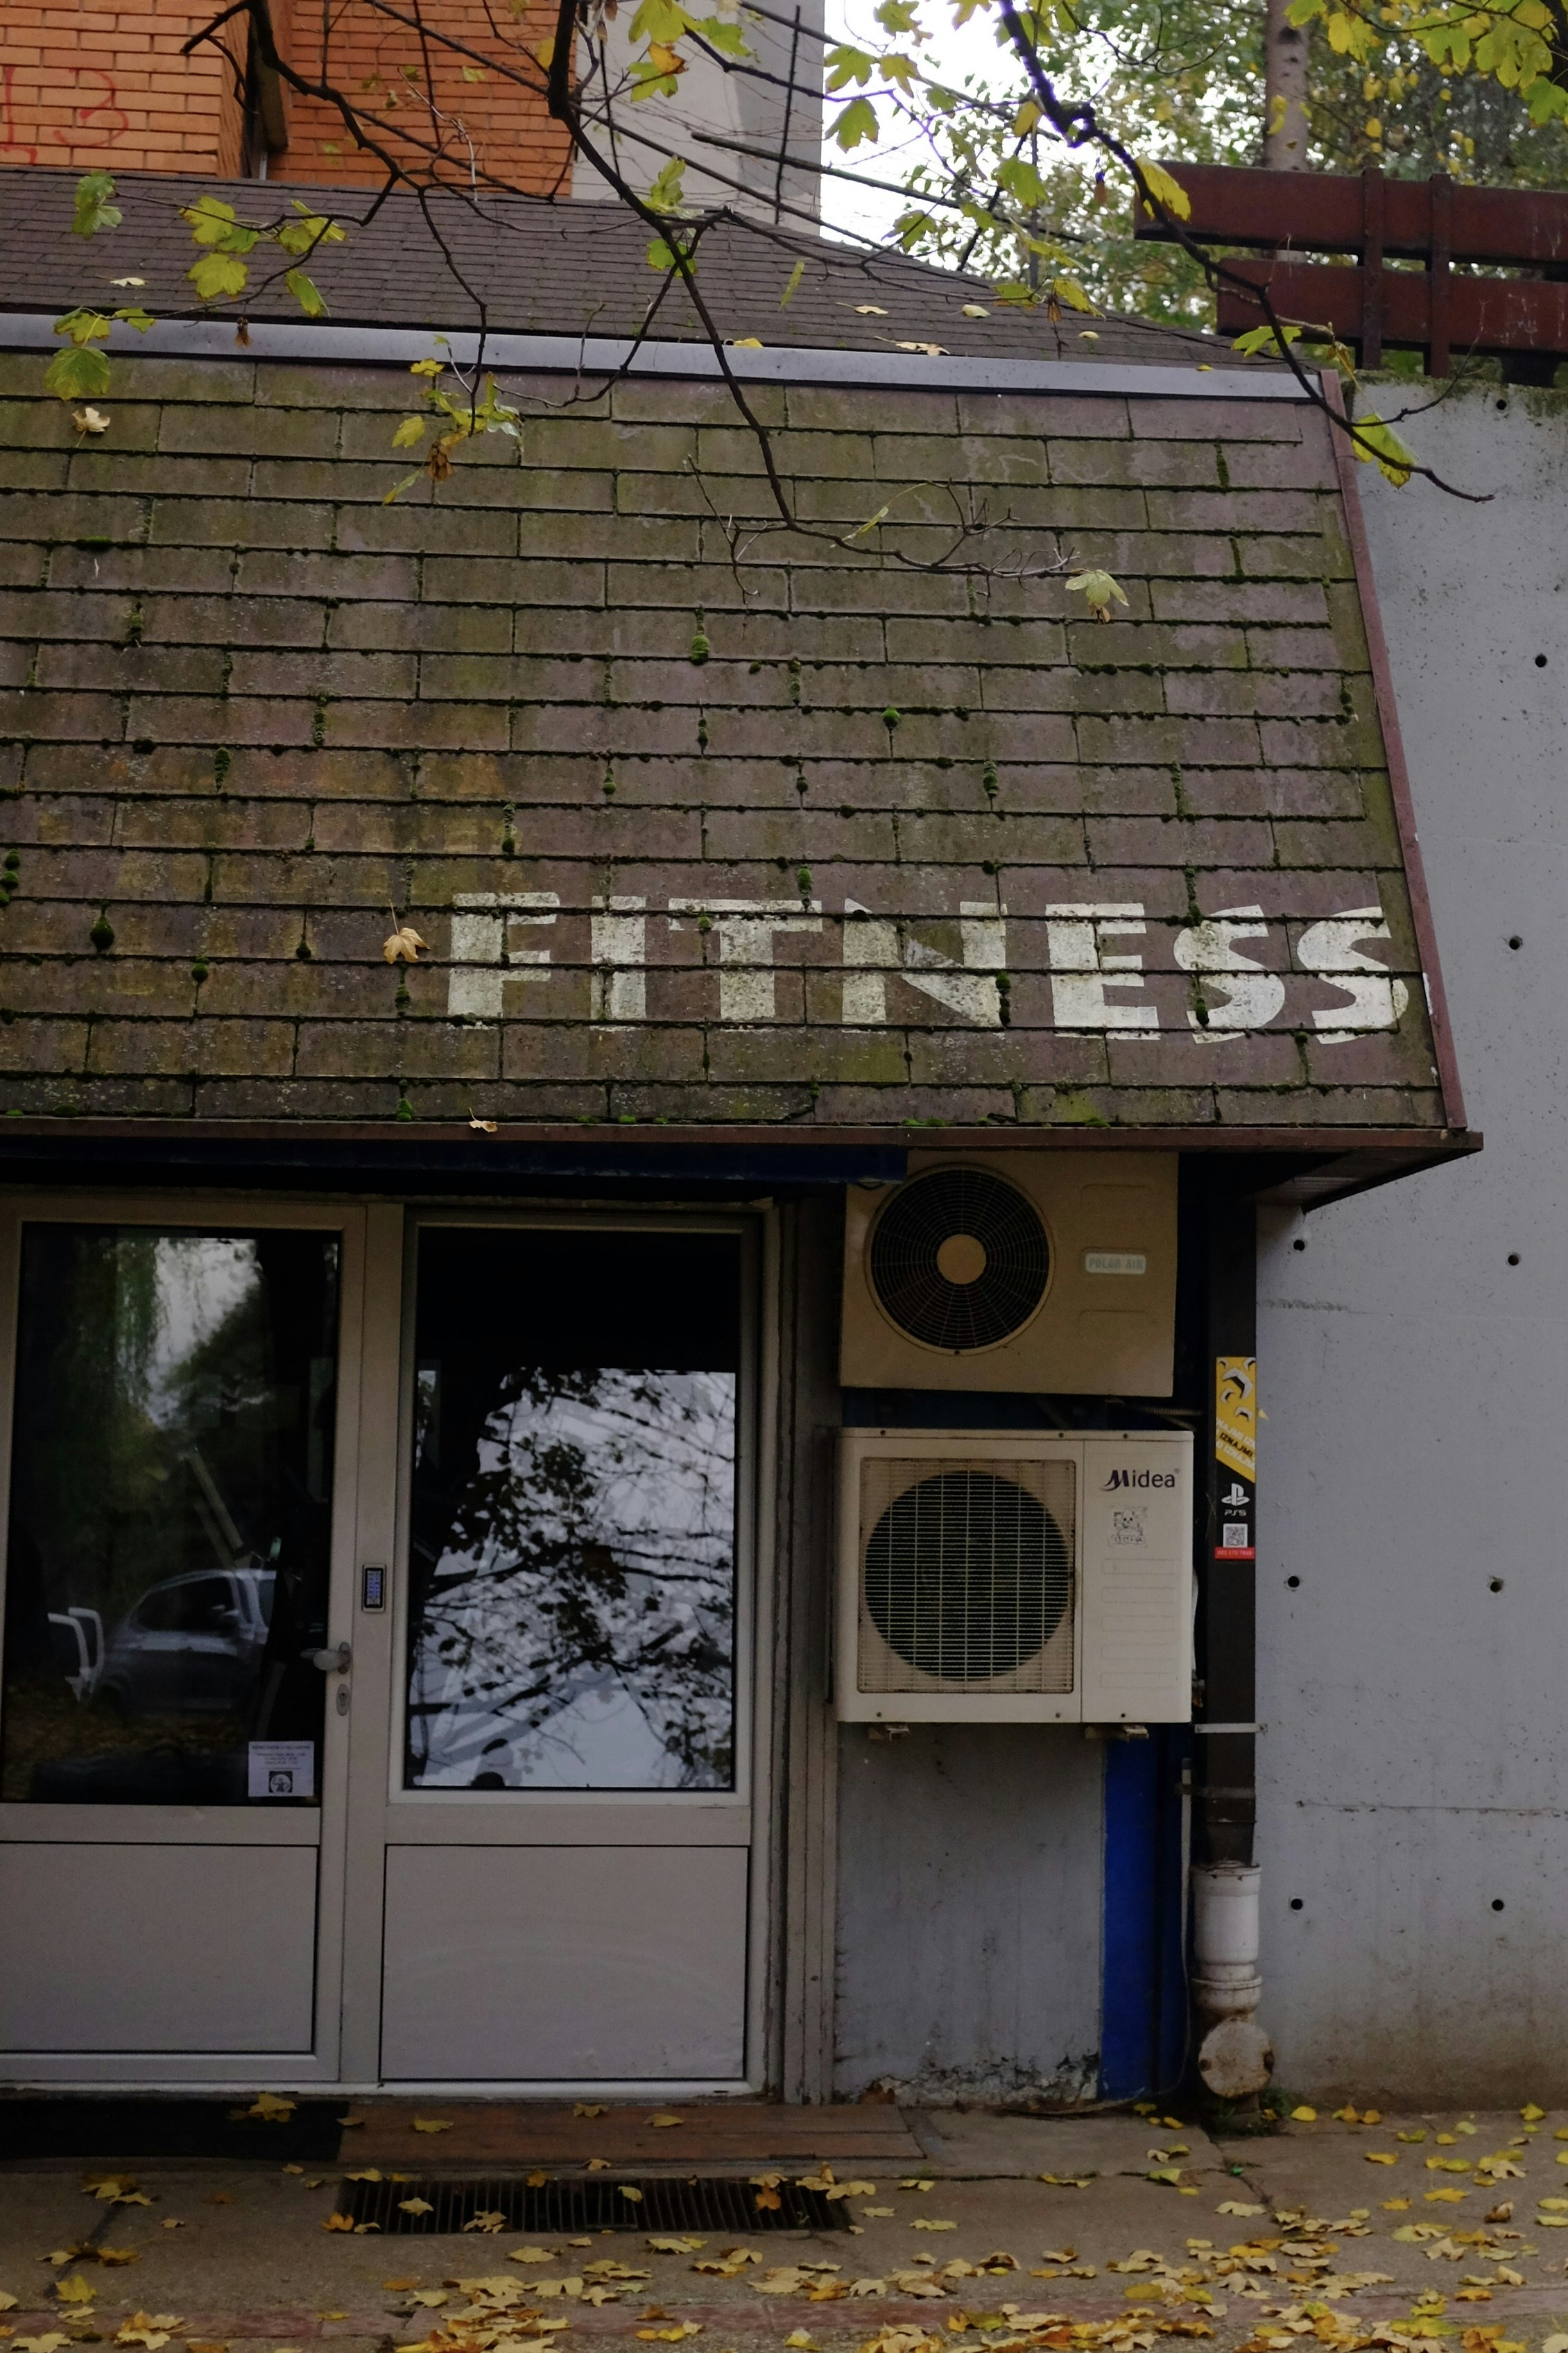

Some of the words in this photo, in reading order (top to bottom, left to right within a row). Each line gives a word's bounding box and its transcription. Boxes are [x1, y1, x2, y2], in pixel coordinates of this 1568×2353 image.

[447, 892, 1408, 1045] FITNESS
[1089, 1258, 1121, 1269] POLAR
[1219, 1432, 1254, 1457] IZNAJMI
[1101, 1469, 1175, 1491] Midea
[1224, 1509, 1247, 1517] PS5
